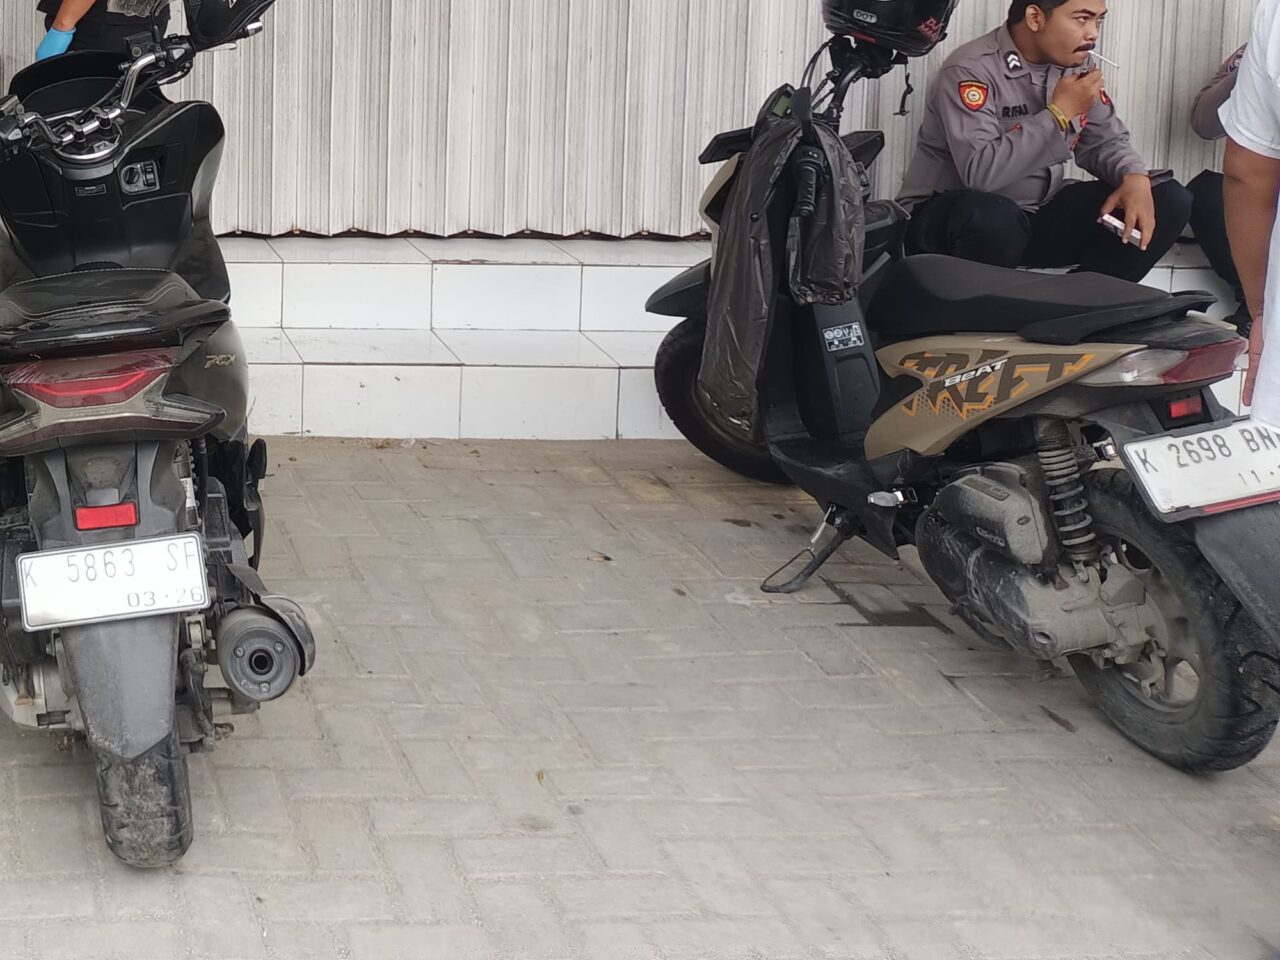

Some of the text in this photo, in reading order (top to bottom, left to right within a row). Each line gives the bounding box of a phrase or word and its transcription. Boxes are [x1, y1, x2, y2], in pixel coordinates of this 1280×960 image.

[855, 10, 875, 21] DOT
[1134, 448, 1159, 474] K
[1167, 434, 1232, 468] 2698
[22, 540, 197, 588] K 5863 SF
